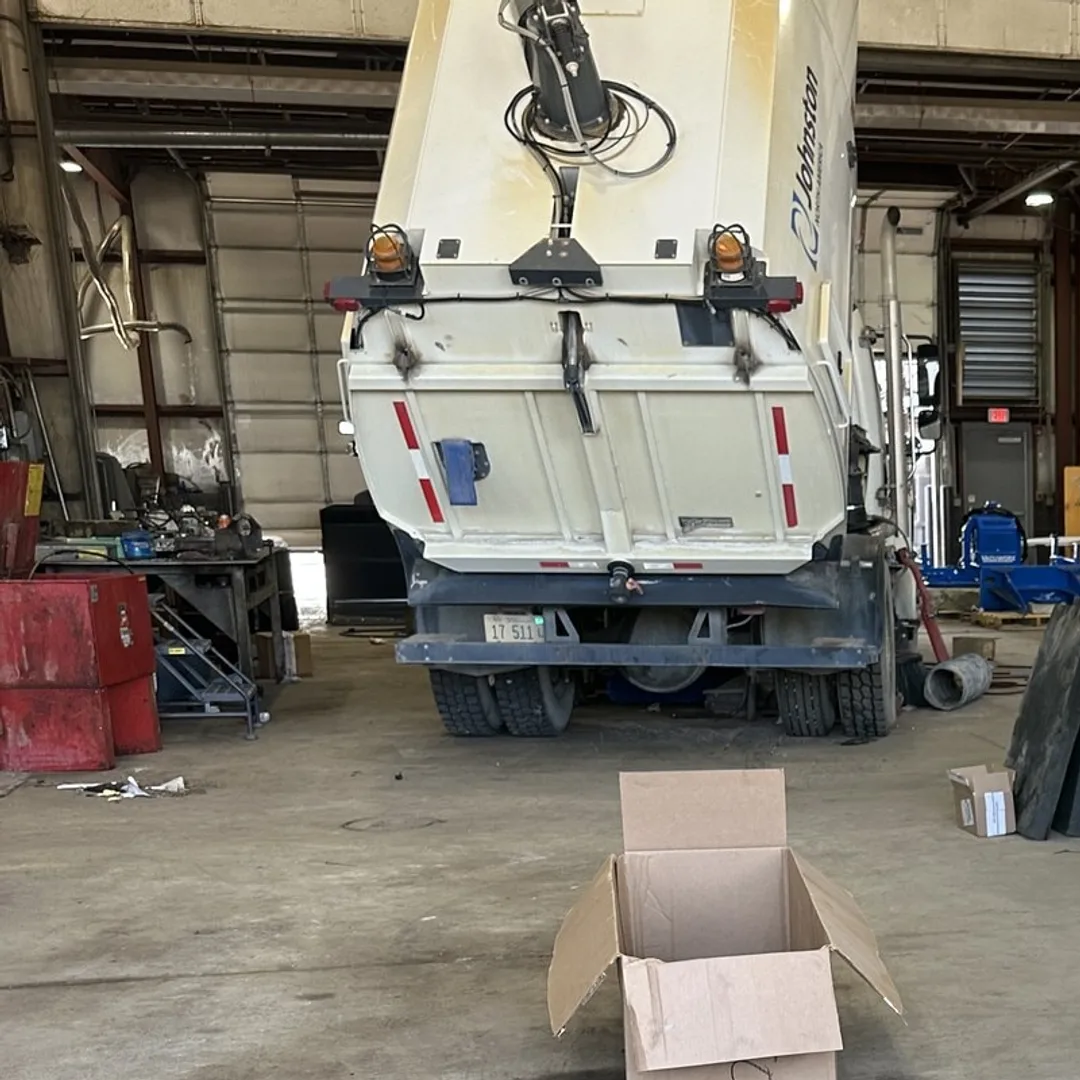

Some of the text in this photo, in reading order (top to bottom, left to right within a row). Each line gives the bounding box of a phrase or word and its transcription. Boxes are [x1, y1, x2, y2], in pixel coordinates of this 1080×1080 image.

[796, 67, 818, 210] Johnston
[492, 623, 505, 640] 17
[511, 623, 534, 641] 511
